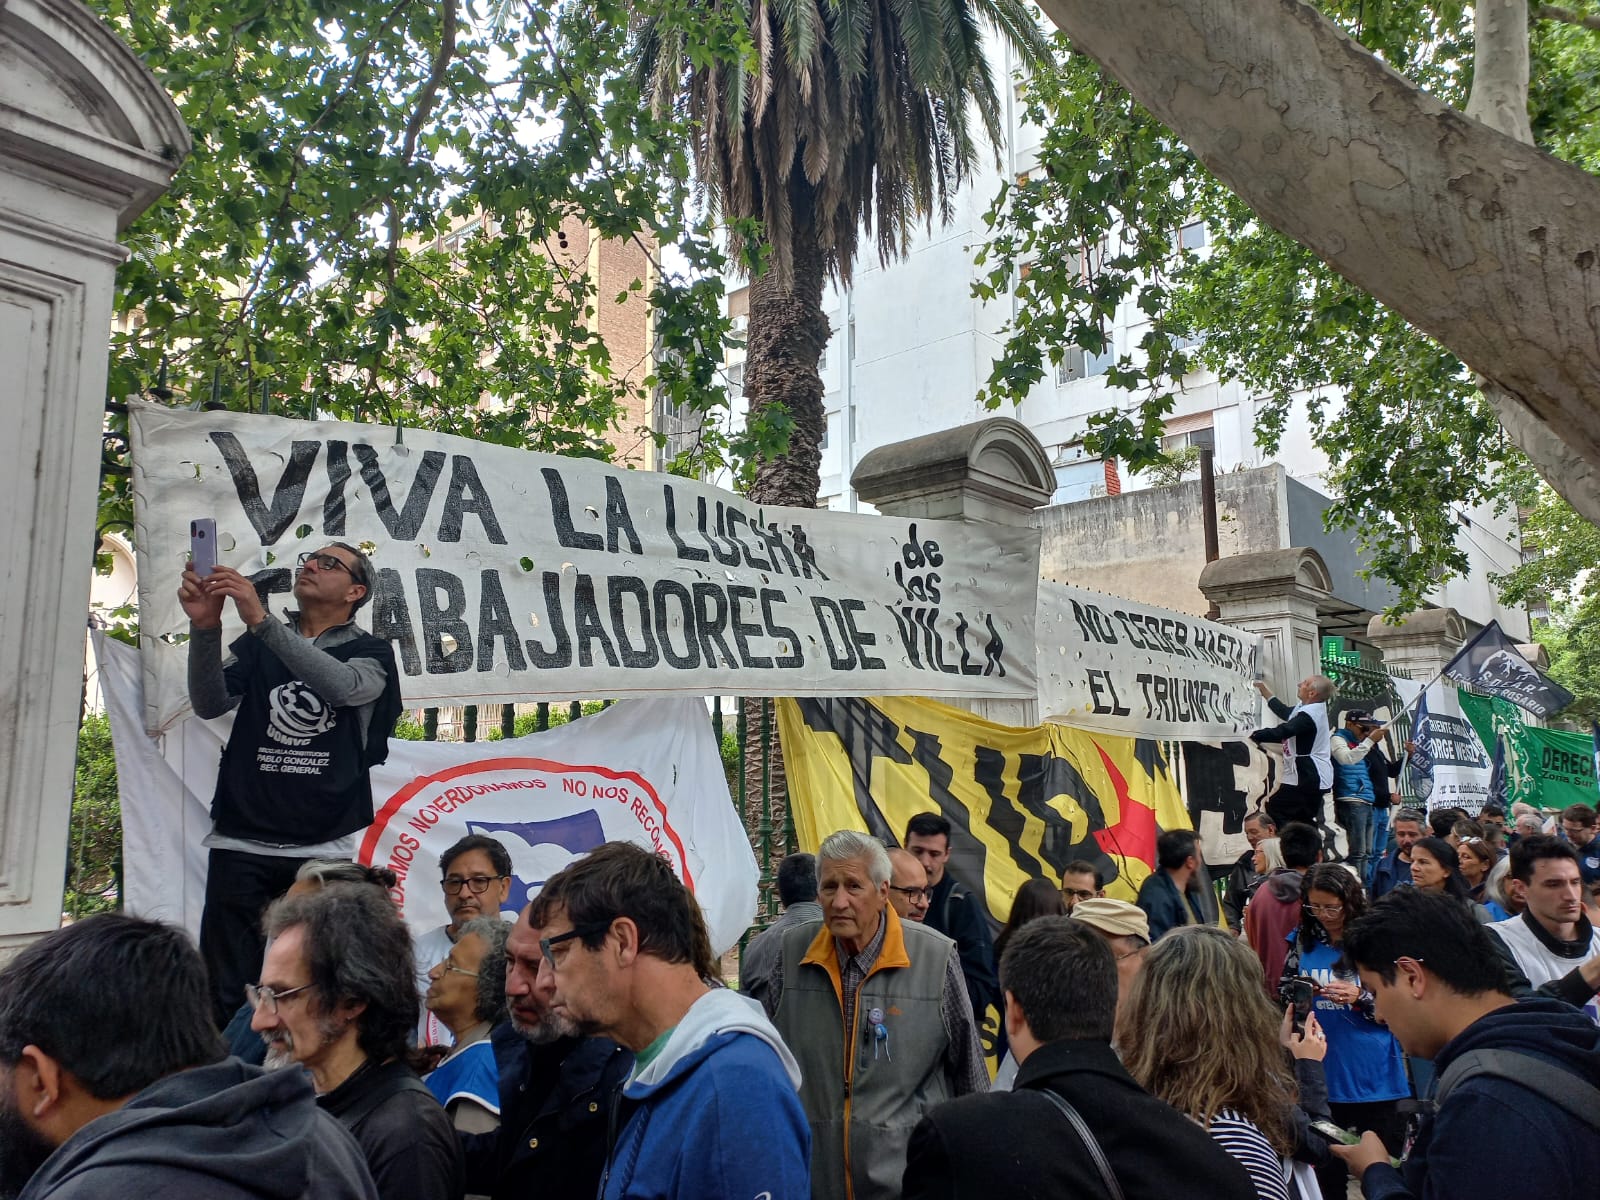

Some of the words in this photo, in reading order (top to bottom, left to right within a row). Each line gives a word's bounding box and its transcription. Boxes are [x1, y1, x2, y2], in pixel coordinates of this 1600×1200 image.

[208, 431, 508, 546] VIVA
[541, 467, 644, 555] LA
[663, 484, 830, 581] LUCHA
[903, 522, 944, 570] de
[895, 561, 941, 605] las
[243, 566, 805, 677] TABAJADORES
[810, 596, 887, 671] DE
[885, 604, 1006, 678] VILLA
[1068, 598, 1118, 645] NO
[1113, 610, 1197, 660] CEDER
[1194, 625, 1247, 678] HASTA
[1085, 668, 1130, 717] EL
[1136, 673, 1227, 723] TRIUNFO
[1500, 688, 1547, 715] ROSARIO
[256, 753, 282, 763] PABLO
[283, 756, 330, 766] GONZALEZ
[280, 765, 322, 775] GENERAL
[1430, 738, 1455, 760] ORGE
[1542, 770, 1570, 783] Zona
[1573, 776, 1594, 788] Sur
[407, 808, 440, 834] NO
[562, 778, 588, 797] NO
[592, 784, 629, 804] NOS
